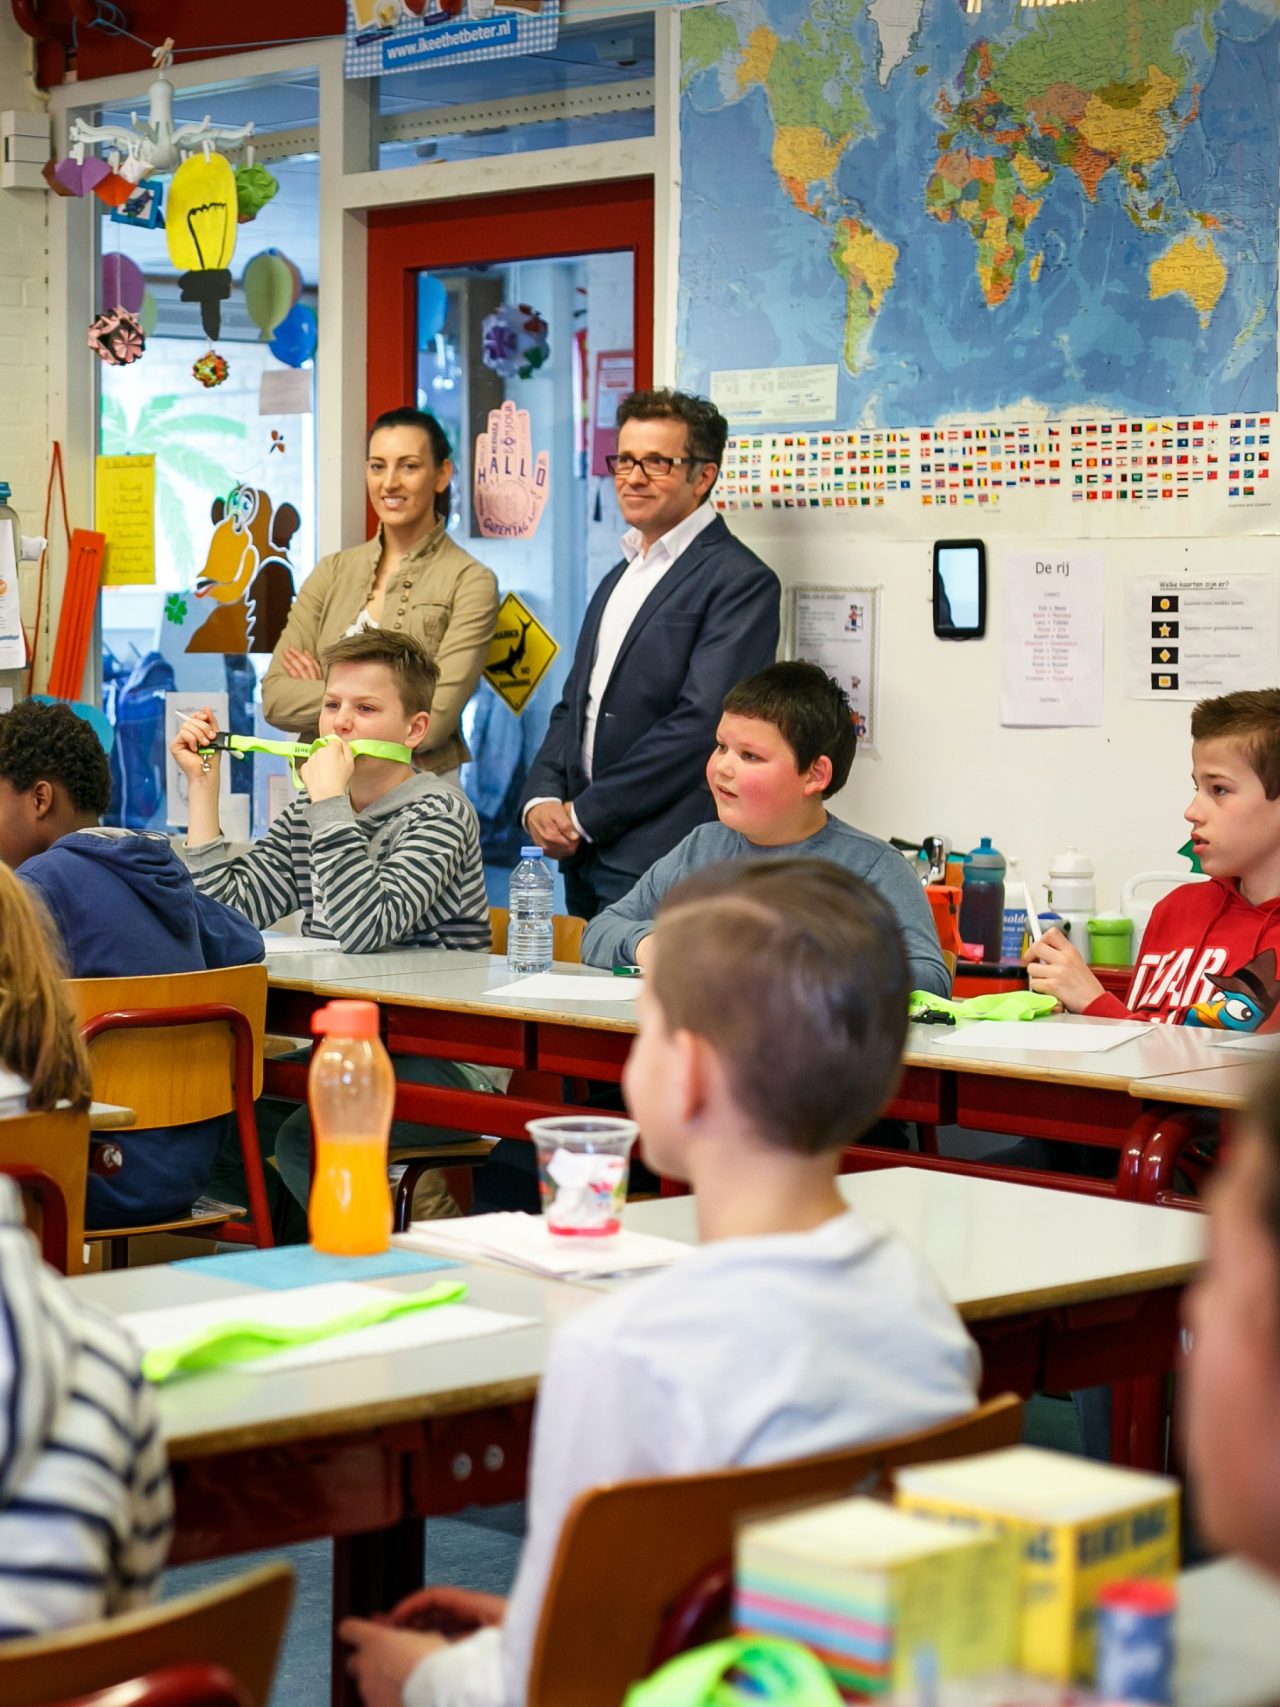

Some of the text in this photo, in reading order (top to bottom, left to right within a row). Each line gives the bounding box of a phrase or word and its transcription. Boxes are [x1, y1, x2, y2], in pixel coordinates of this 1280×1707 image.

[386, 20, 511, 60] www.ikeethetbeter.nl
[1035, 561, 1070, 577] De rij
[1160, 581, 1177, 589] Welke
[1205, 581, 1217, 589] zijn
